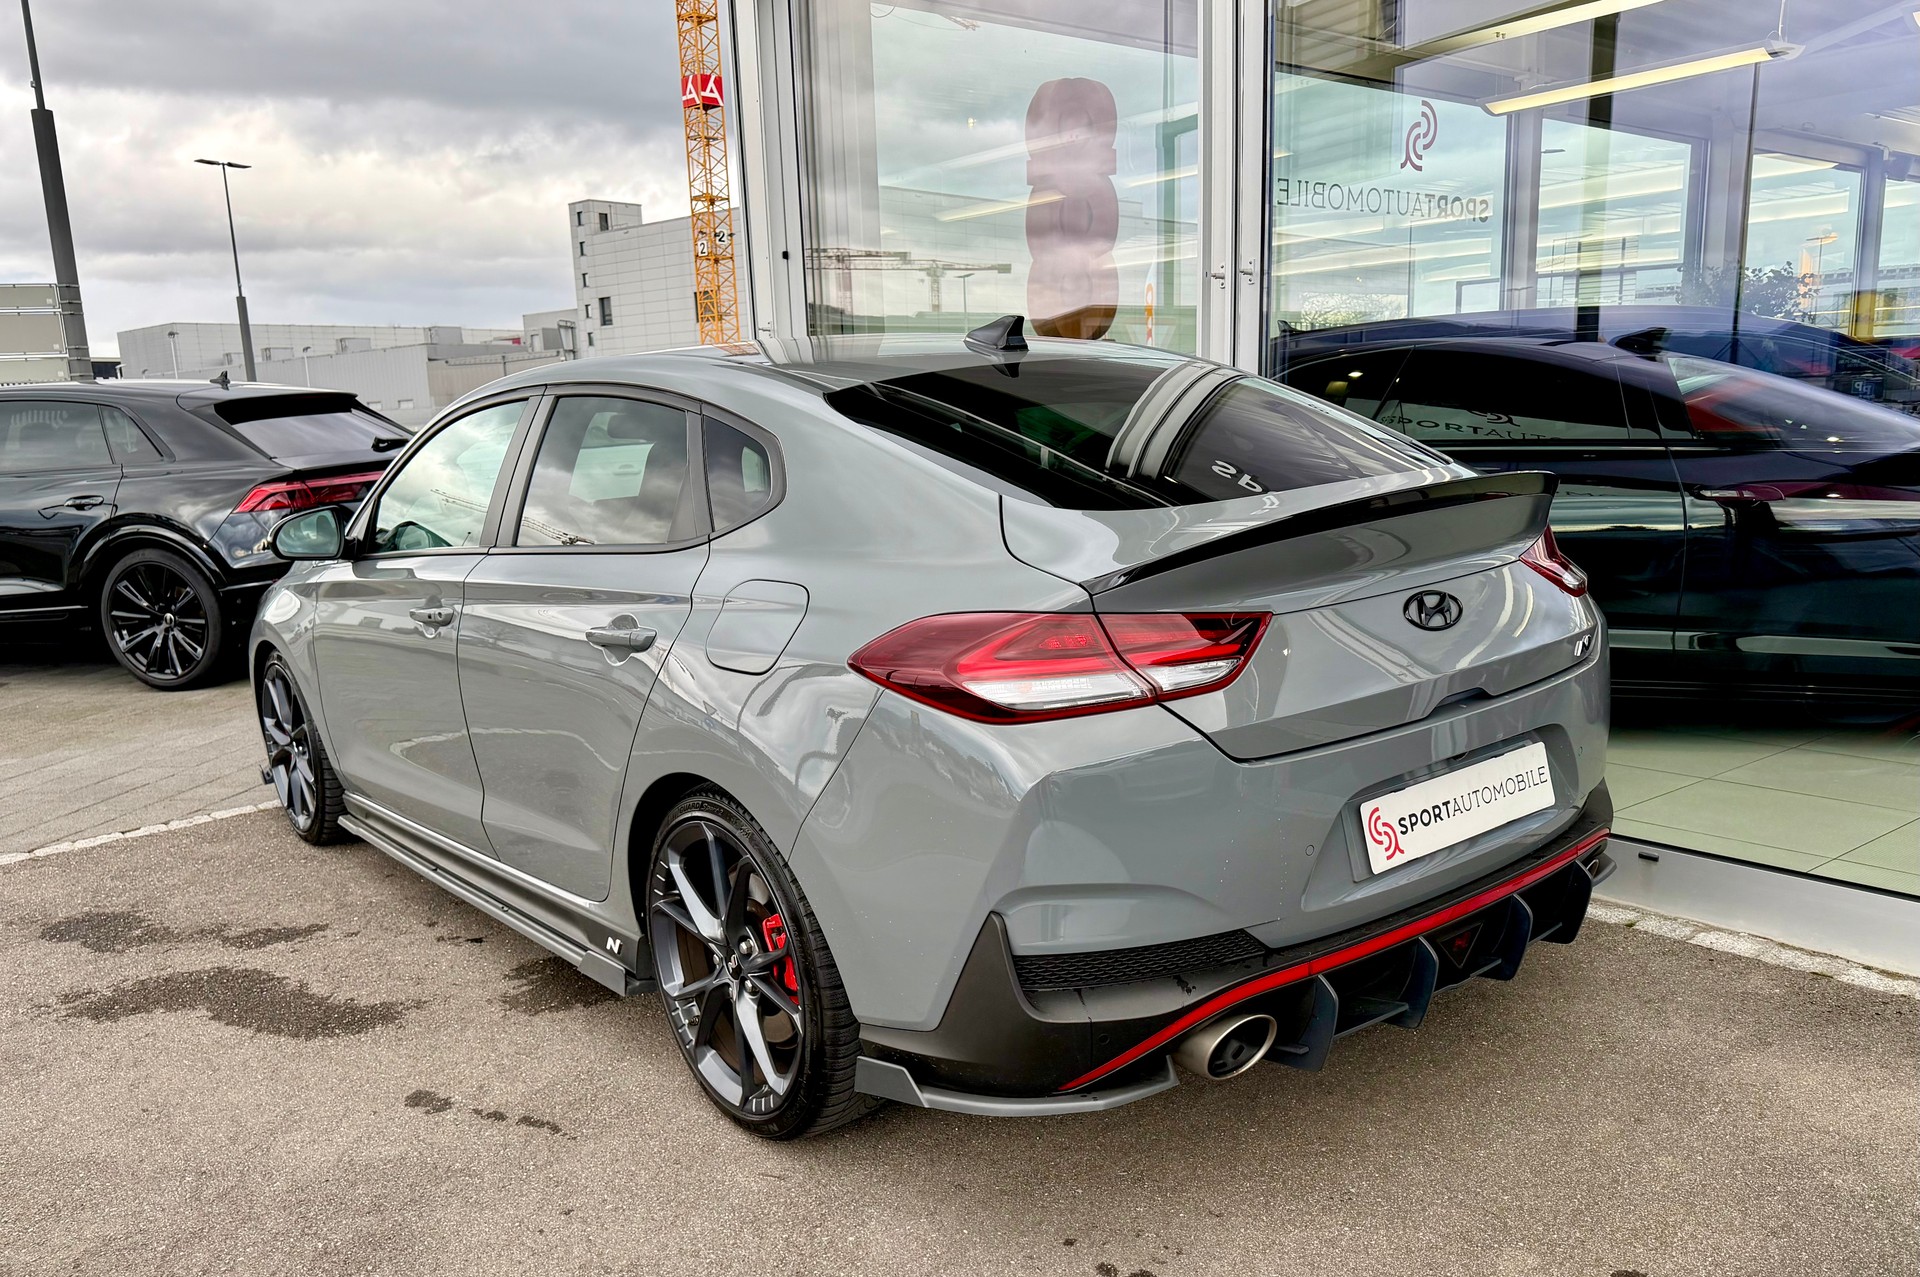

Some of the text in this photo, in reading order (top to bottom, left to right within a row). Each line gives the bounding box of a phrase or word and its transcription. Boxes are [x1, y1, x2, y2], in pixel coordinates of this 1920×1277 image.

[718, 230, 725, 243] 2
[699, 242, 706, 255] 2
[1398, 766, 1548, 835] SPORTAUTOMOBILE
[606, 936, 622, 954] N
